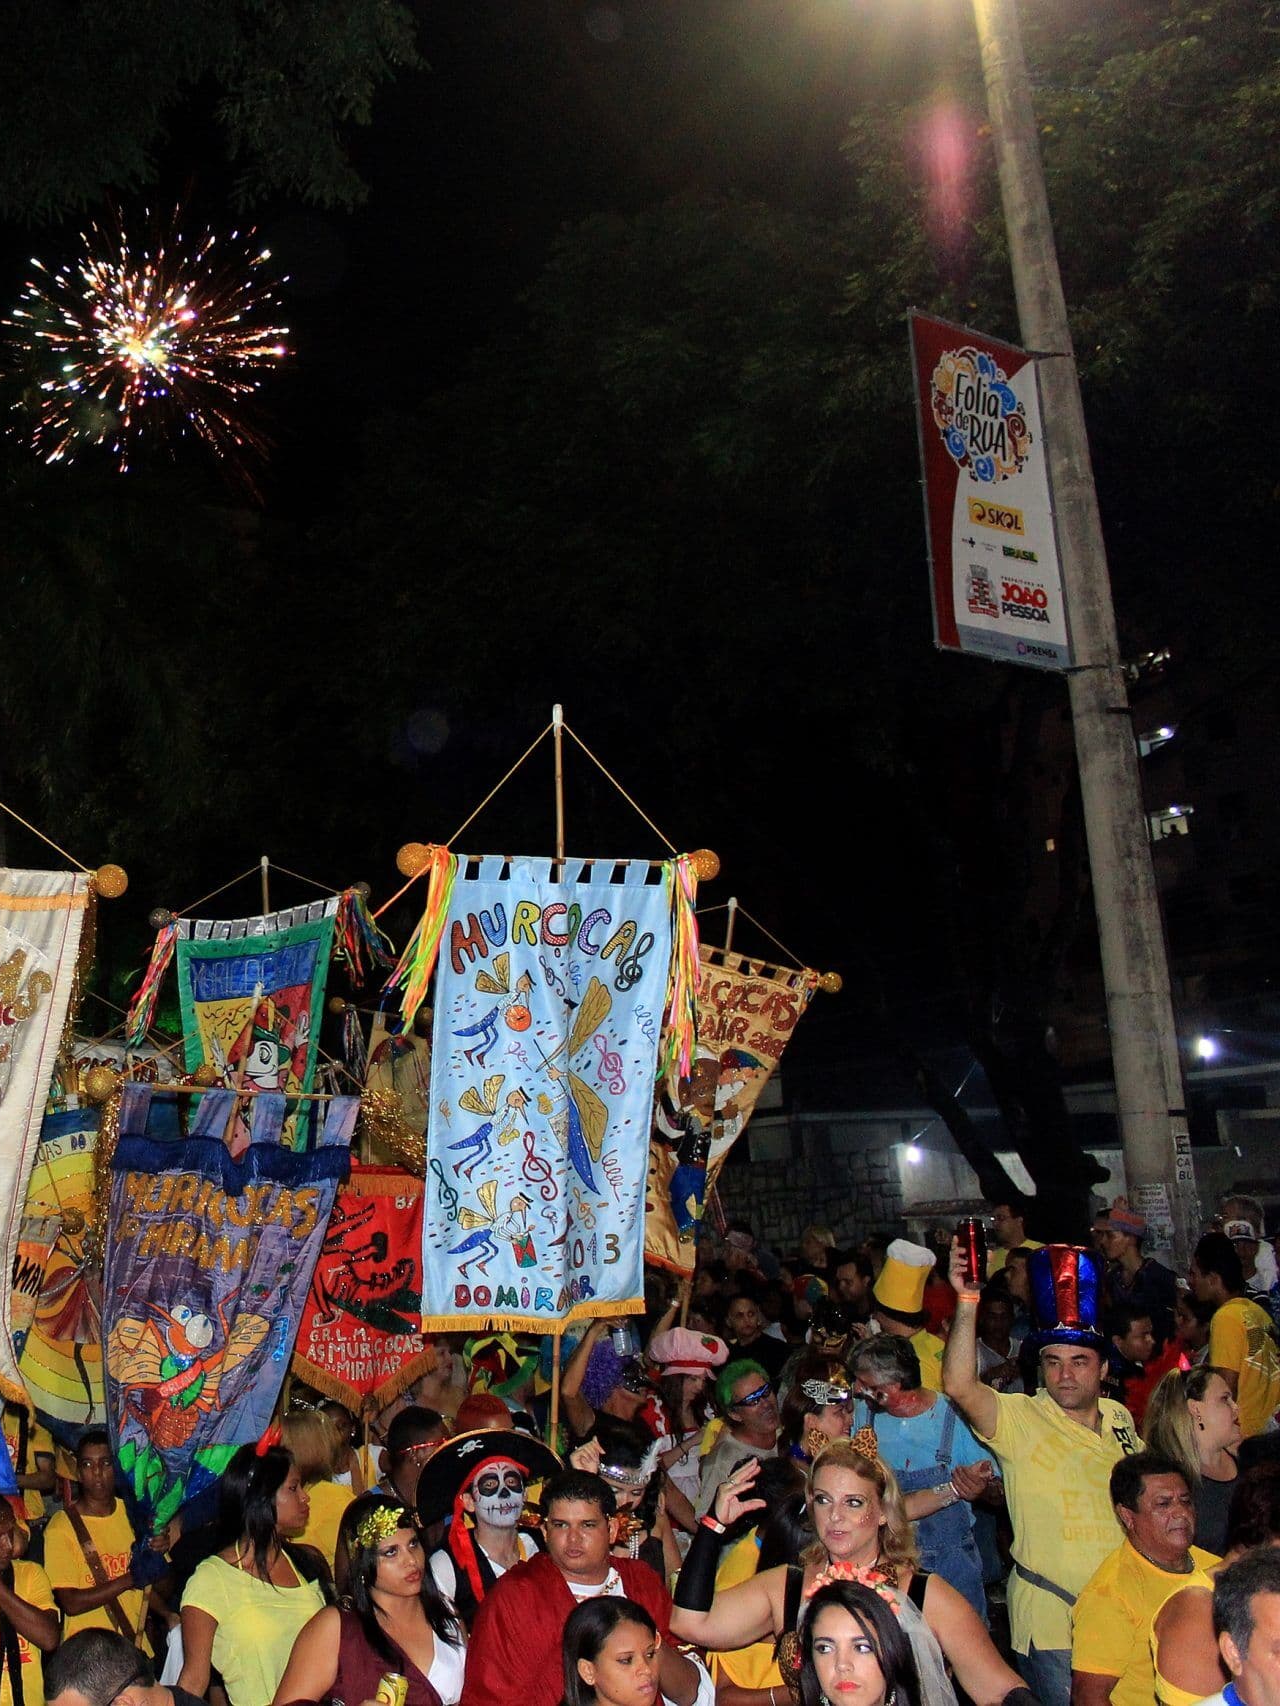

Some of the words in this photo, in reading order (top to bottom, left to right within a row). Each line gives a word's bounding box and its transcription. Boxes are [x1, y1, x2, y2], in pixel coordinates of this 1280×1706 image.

[955, 373, 999, 419] Folia
[955, 410, 970, 431] de
[969, 414, 1007, 462] RUA
[987, 507, 1022, 531] SKOL
[1001, 602, 1051, 624] PESSOA
[306, 1343, 326, 1363] AS
